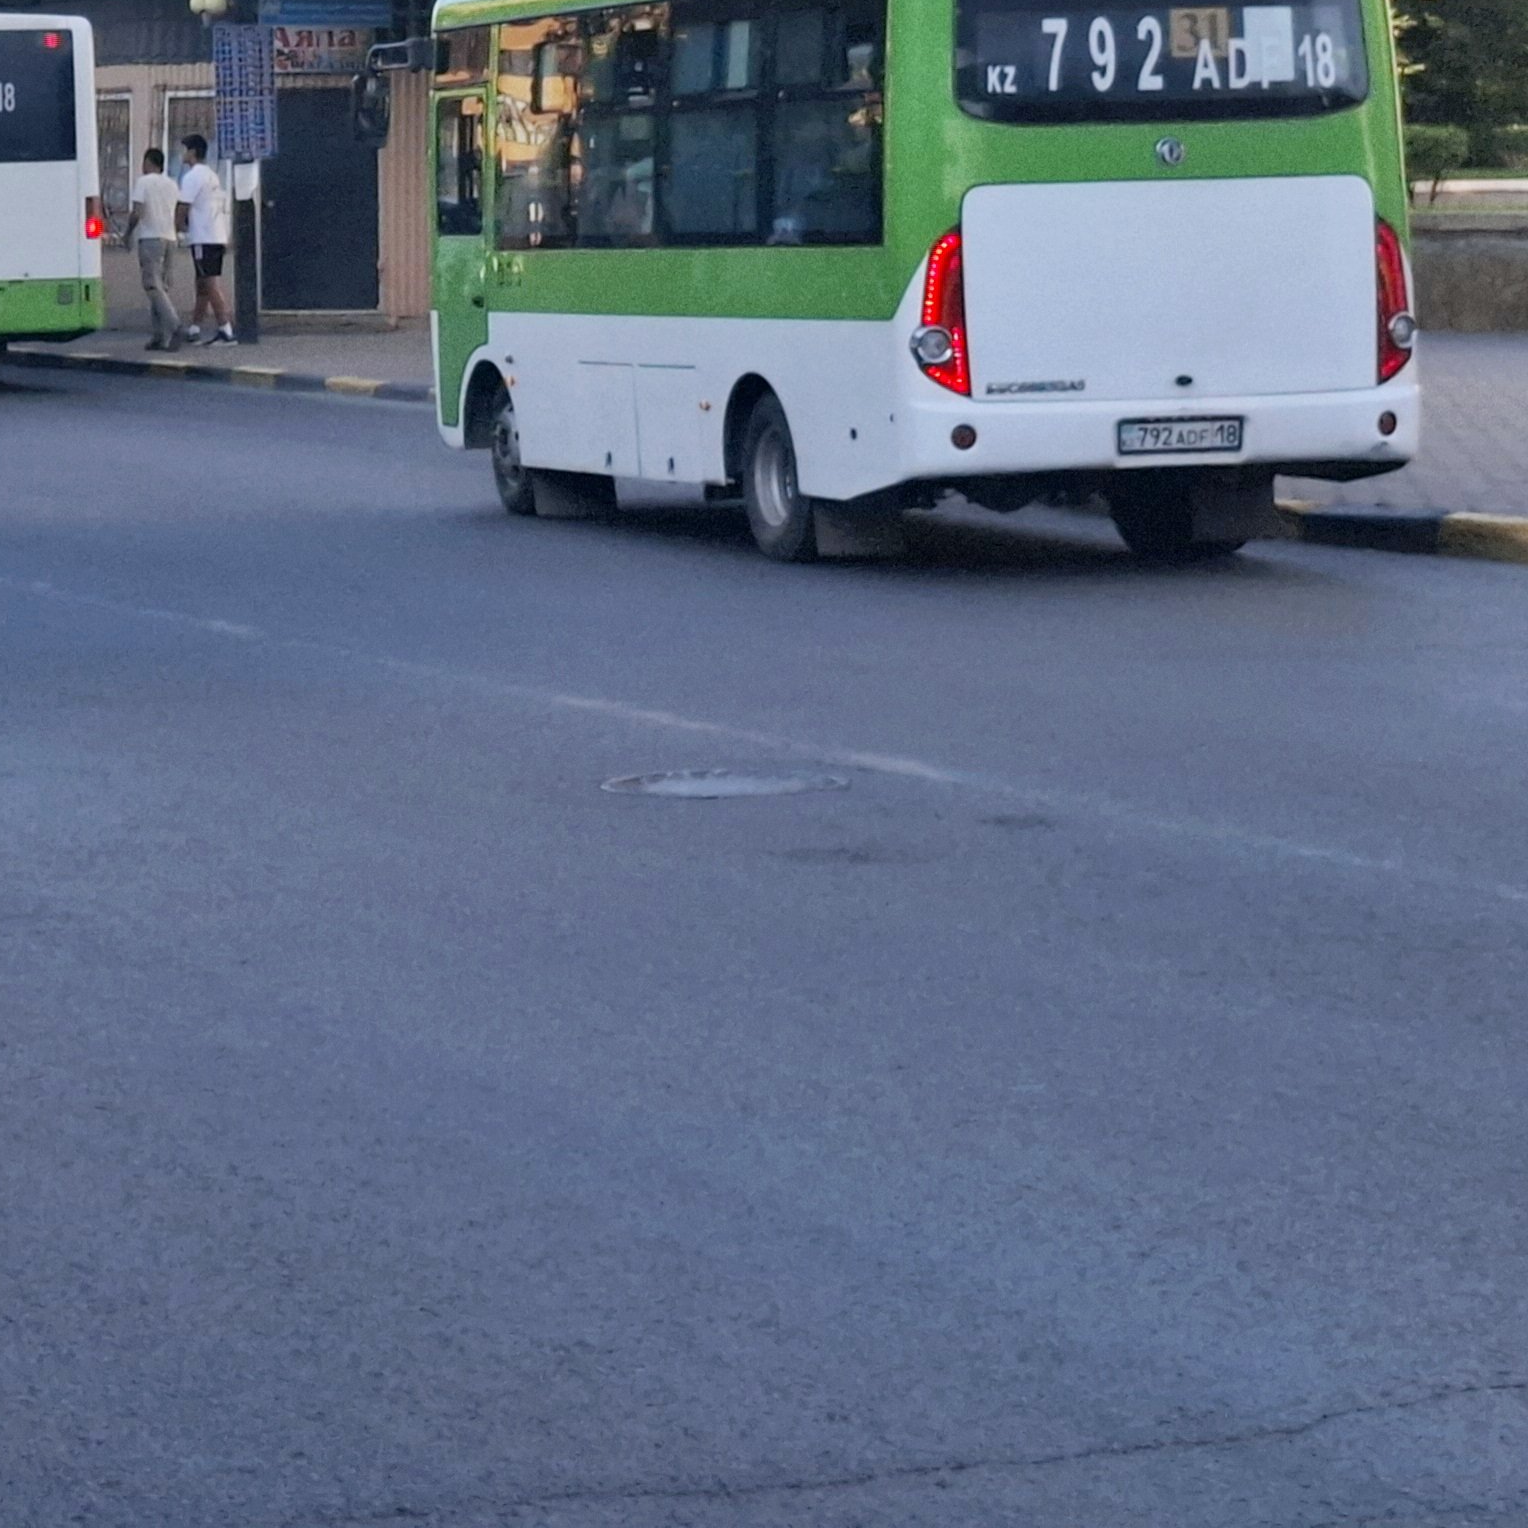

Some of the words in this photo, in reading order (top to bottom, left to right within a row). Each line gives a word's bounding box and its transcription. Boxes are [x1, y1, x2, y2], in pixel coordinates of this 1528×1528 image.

[1176, 12, 1220, 52] 31
[987, 65, 1018, 94] KZ
[1040, 16, 1164, 93] 792
[1297, 32, 1336, 88] 18
[1138, 426, 1173, 448] 792
[1175, 428, 1209, 446] ADF
[1215, 424, 1238, 445] 18
